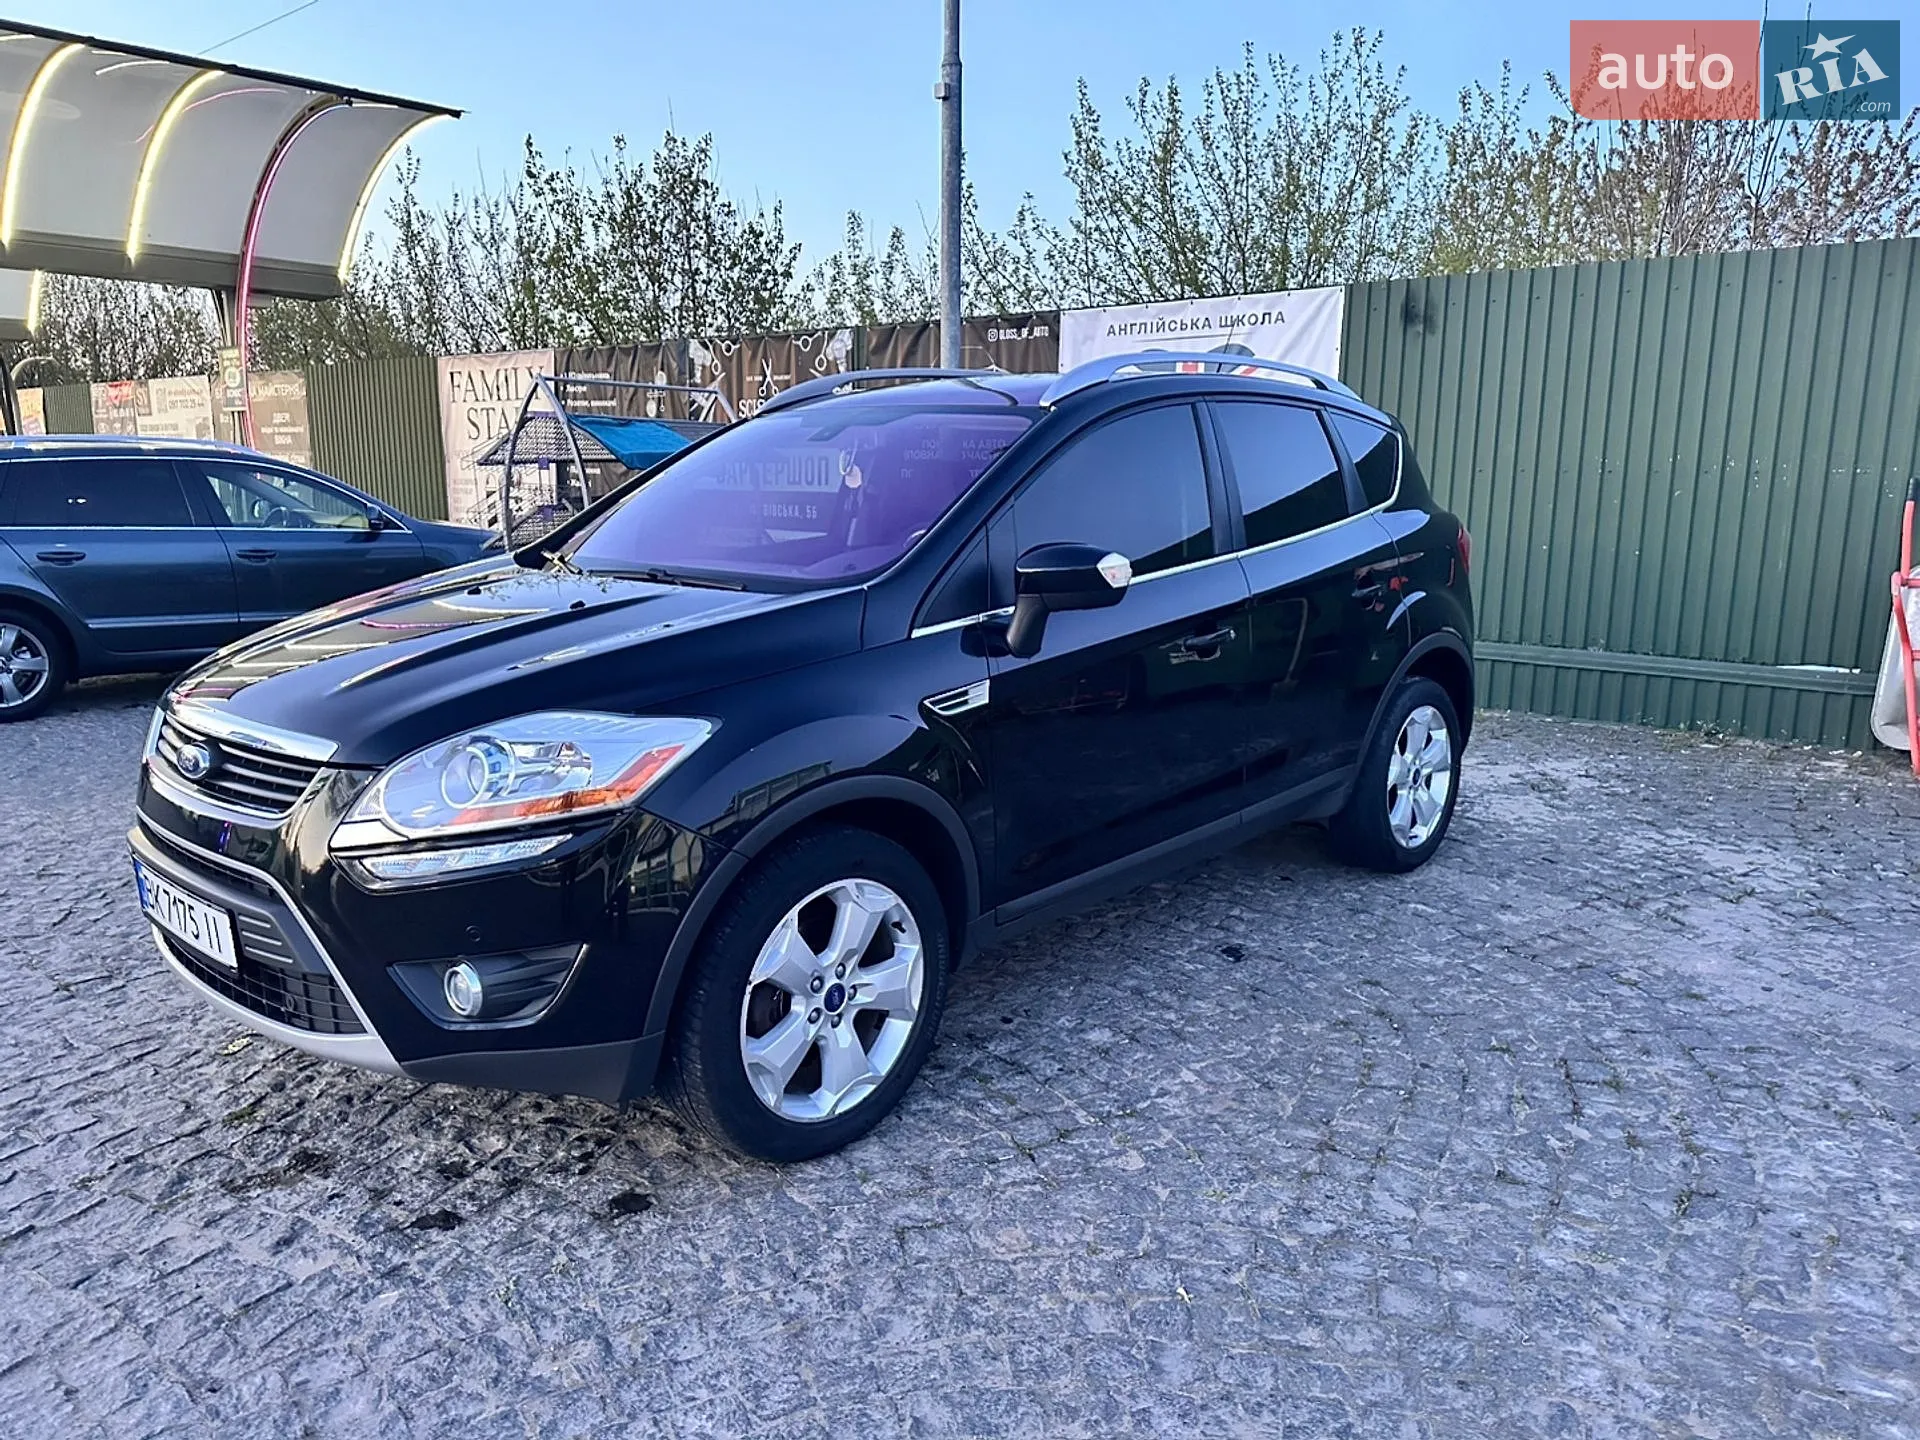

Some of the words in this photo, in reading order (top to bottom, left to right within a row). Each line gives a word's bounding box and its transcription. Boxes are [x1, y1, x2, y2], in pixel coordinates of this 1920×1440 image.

[1106, 317, 1213, 337] АНГЛІЙСЬКА
[1219, 311, 1286, 329] ШКОЛА
[449, 365, 544, 403] FAMILY
[466, 406, 521, 440] STA
[162, 887, 200, 941] 7175
